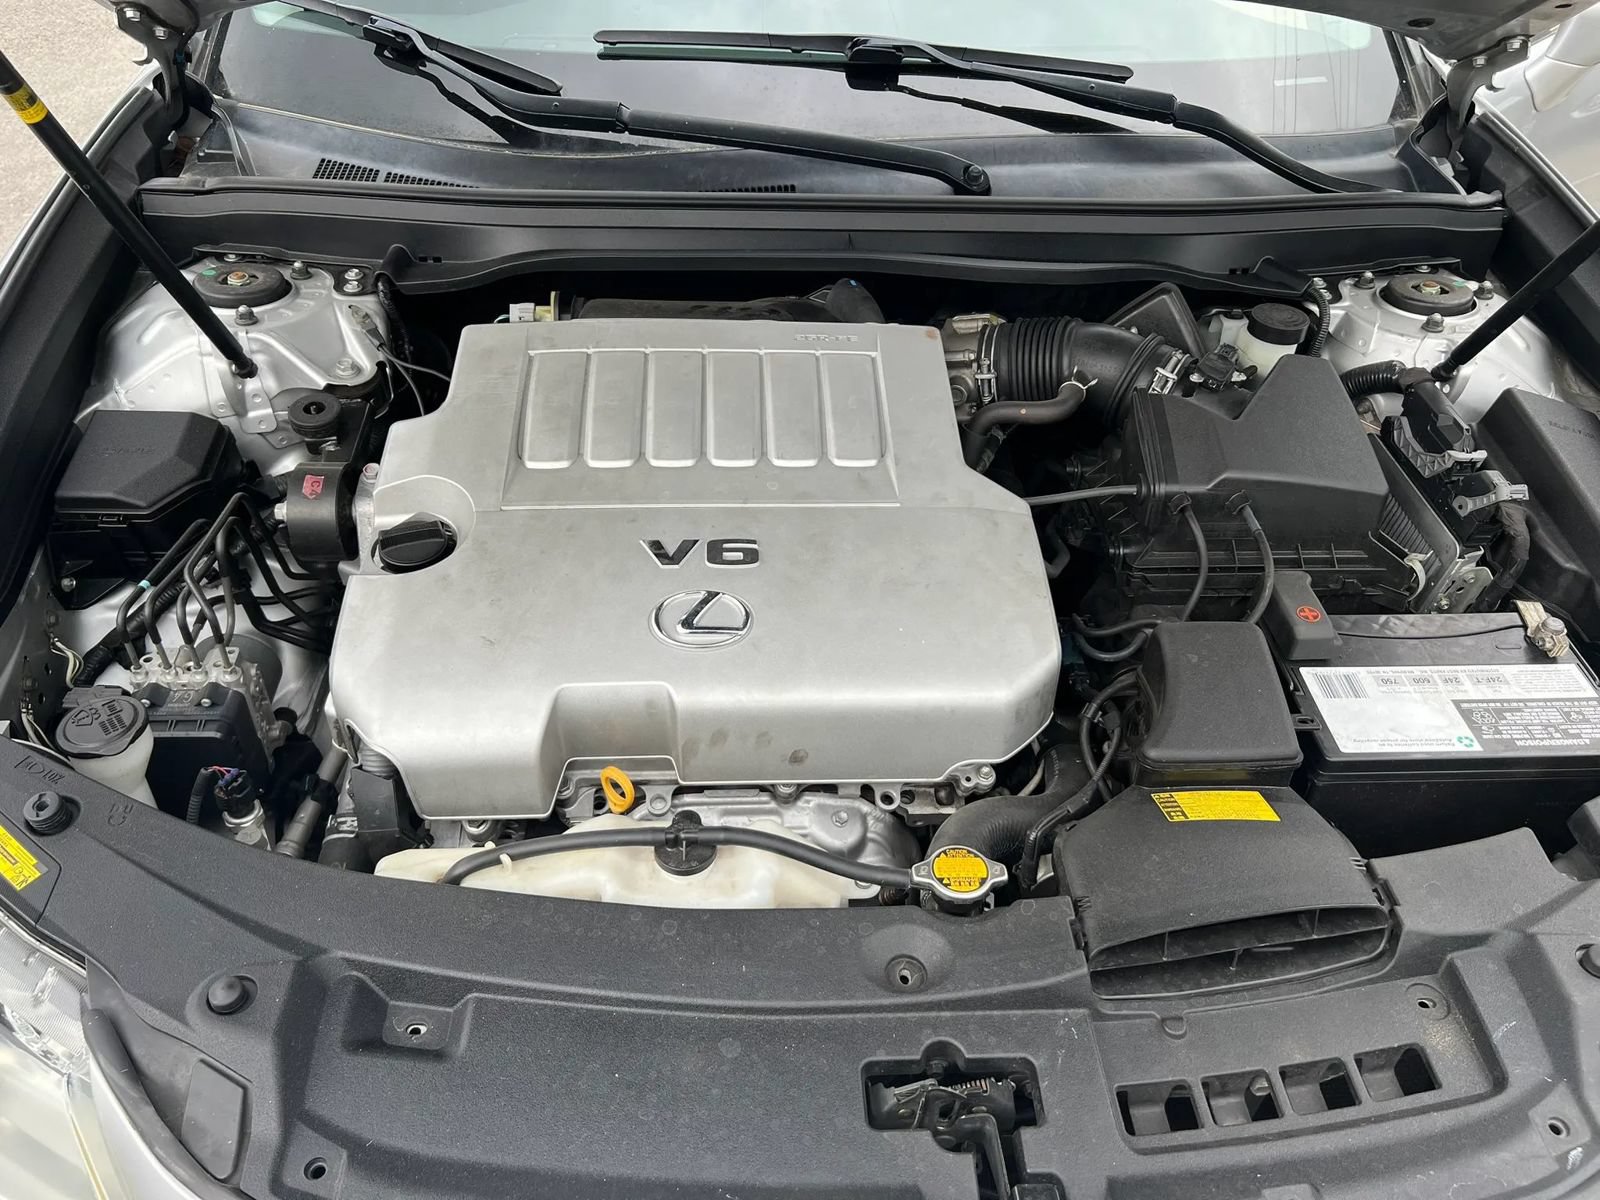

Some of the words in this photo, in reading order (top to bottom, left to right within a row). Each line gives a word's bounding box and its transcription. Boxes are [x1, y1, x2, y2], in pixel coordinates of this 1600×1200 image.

[639, 538, 760, 569] V6
[1380, 677, 1399, 685] 750
[1442, 676, 1461, 684] 24F
